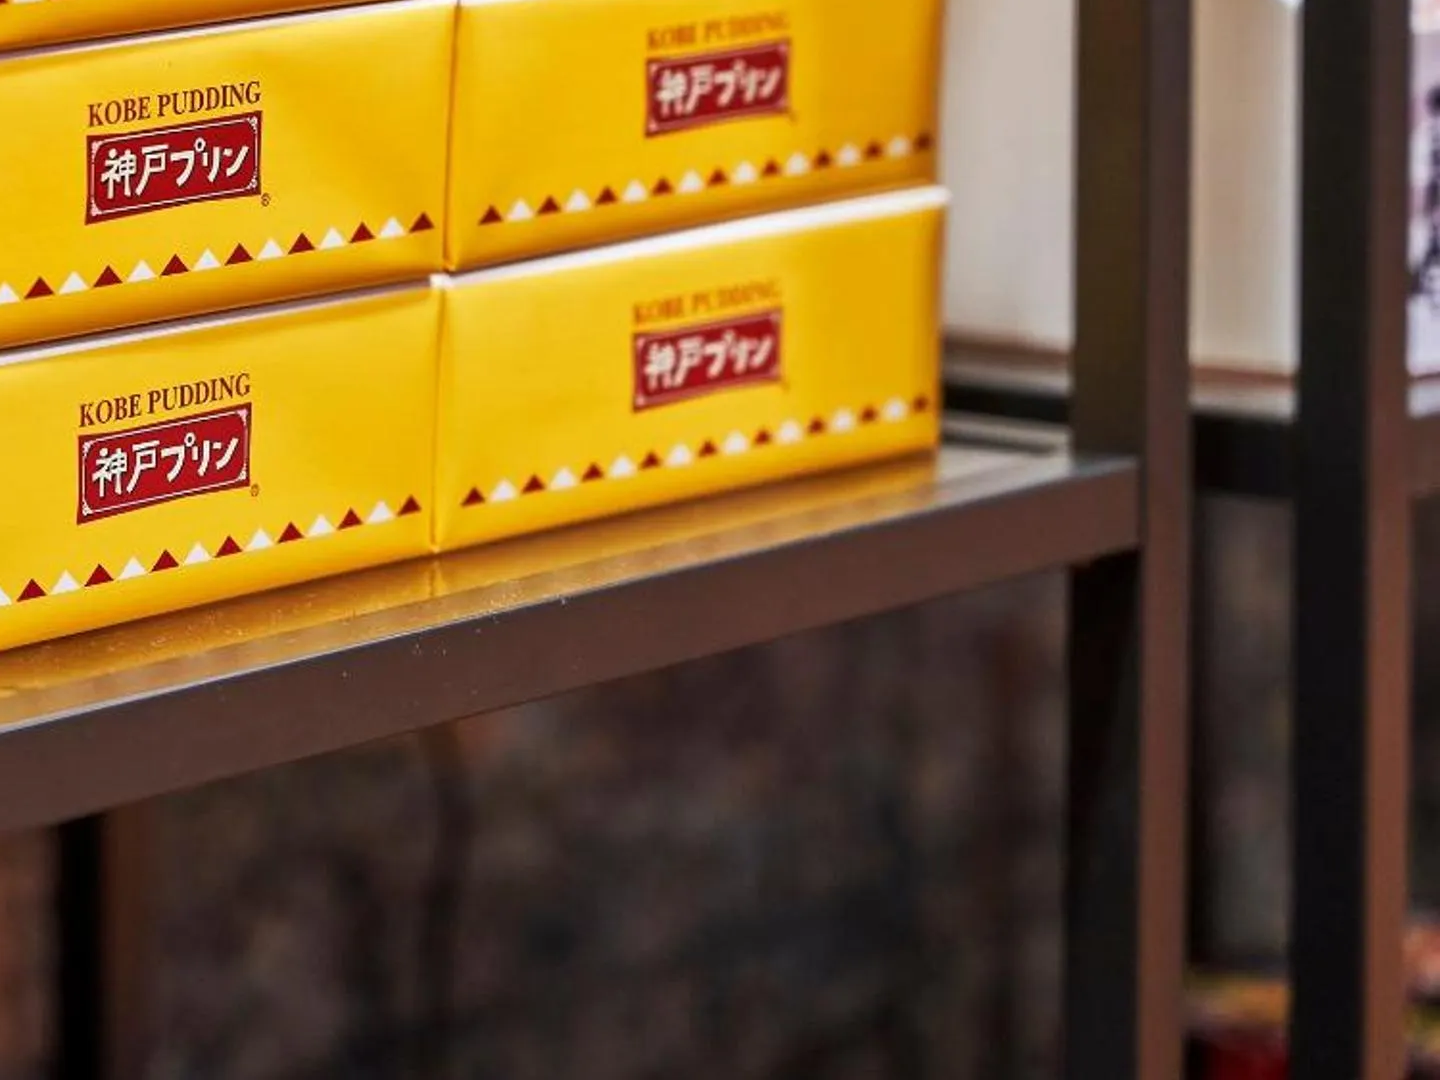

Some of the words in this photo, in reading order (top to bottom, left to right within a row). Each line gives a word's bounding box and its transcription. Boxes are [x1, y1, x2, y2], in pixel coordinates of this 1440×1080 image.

[88, 96, 151, 128] KOBE
[157, 80, 261, 118] PUDDING
[656, 59, 782, 117] 神戸プリン
[101, 138, 249, 200] 神戸プリン
[644, 330, 774, 391] 神戸プリン
[78, 393, 142, 428] KOBE
[148, 372, 251, 415] PUDDING
[92, 432, 240, 498] 神戸プリン
